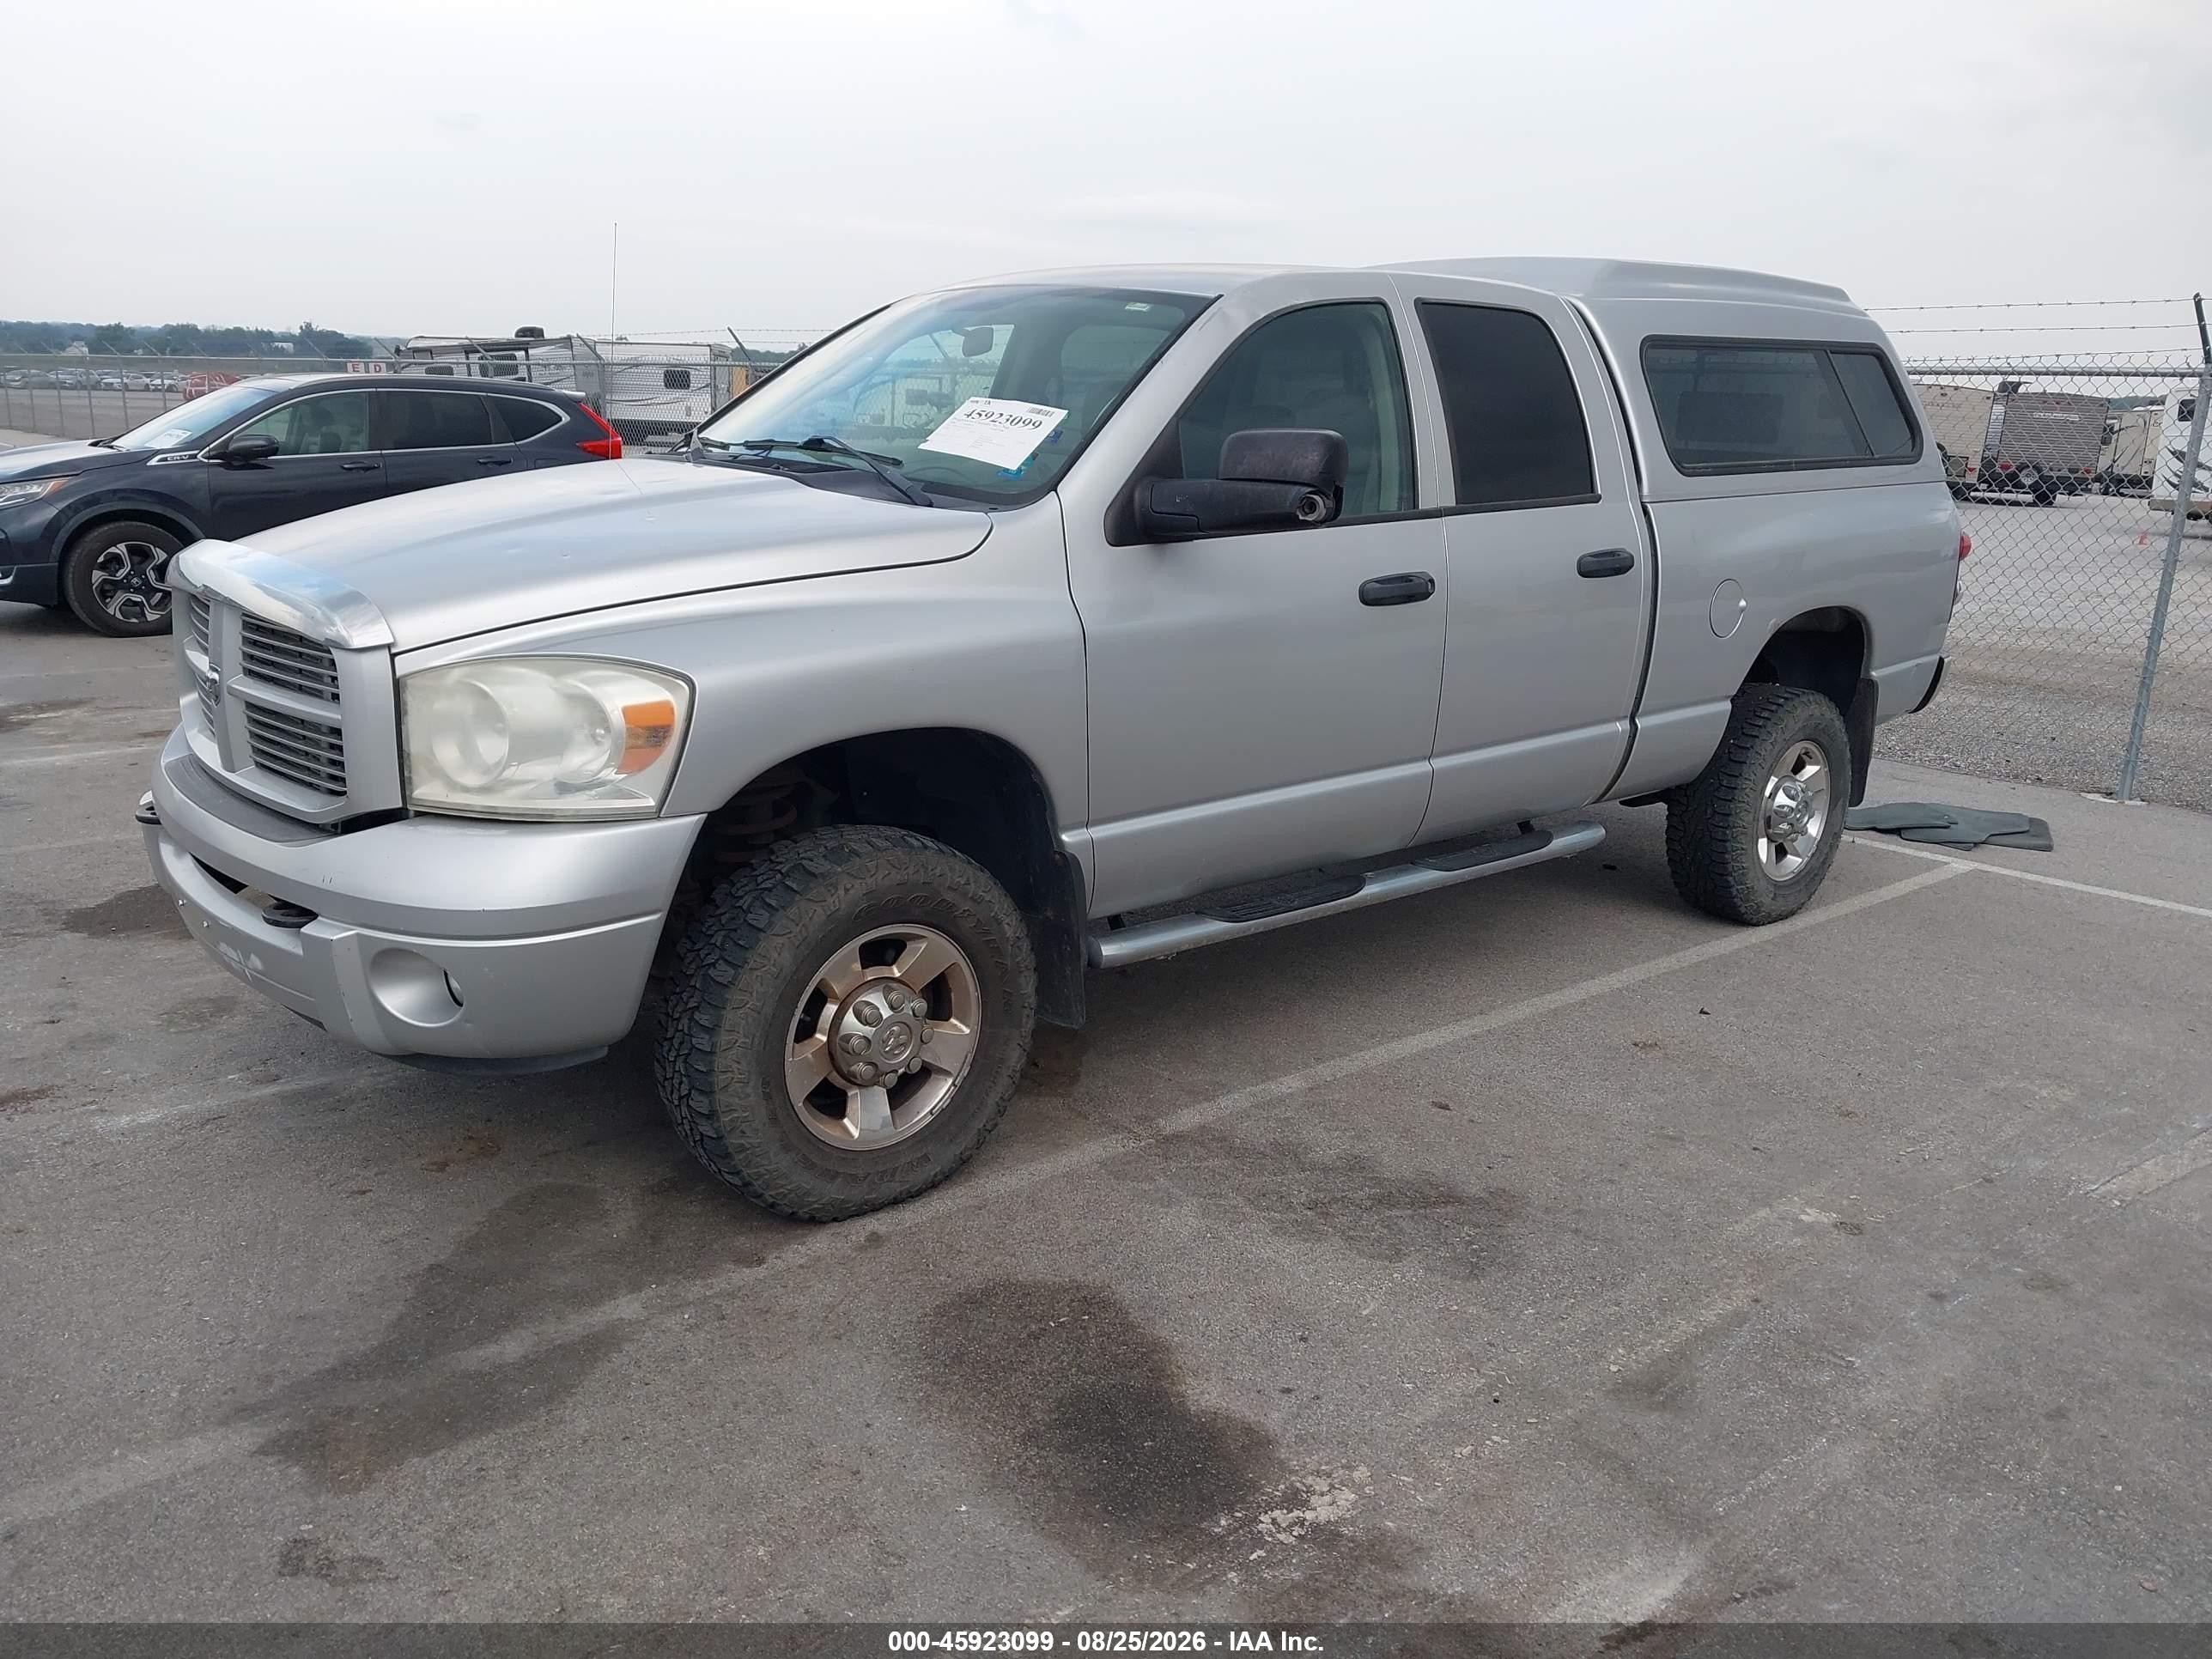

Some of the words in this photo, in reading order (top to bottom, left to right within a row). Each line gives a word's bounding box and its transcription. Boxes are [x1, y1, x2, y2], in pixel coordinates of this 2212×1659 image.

[351, 363, 360, 372] E
[373, 363, 382, 373] D
[963, 408, 1042, 430] 45923099
